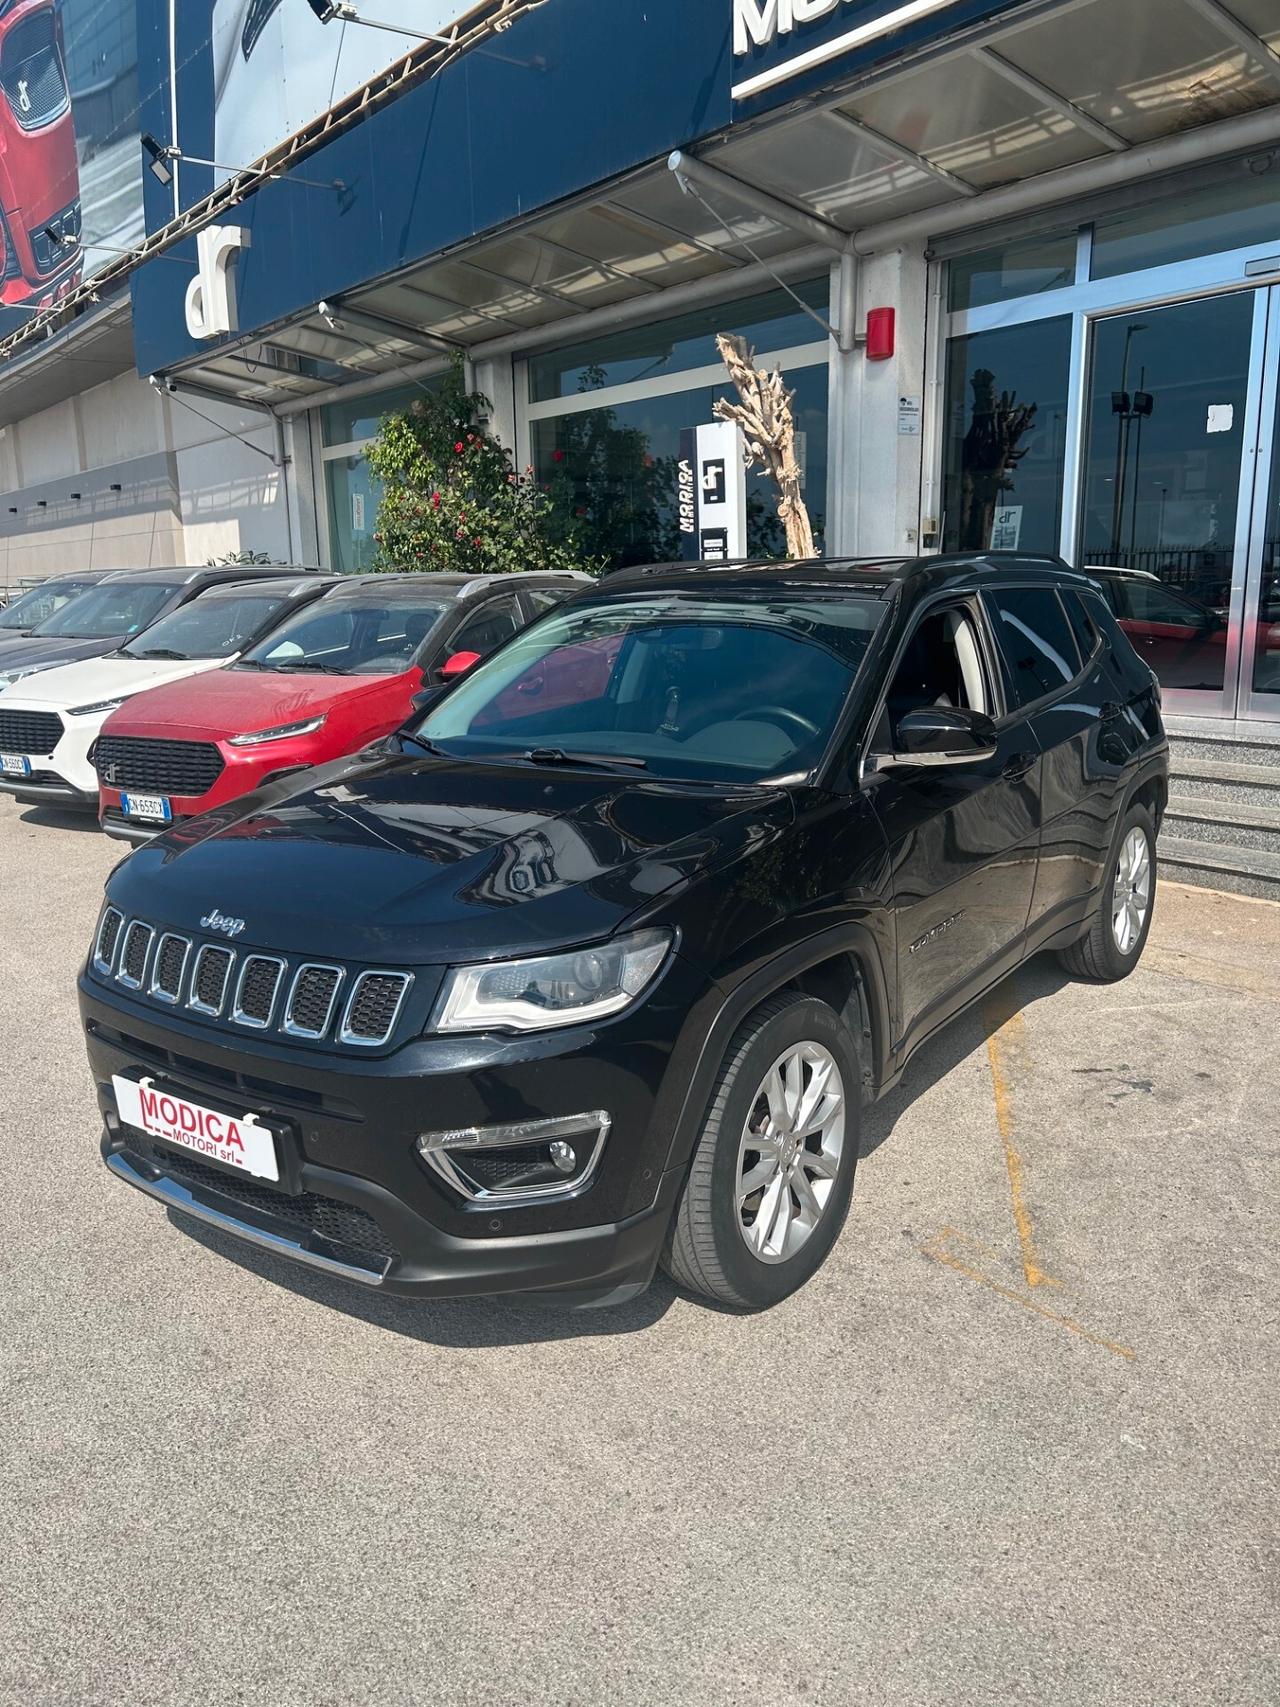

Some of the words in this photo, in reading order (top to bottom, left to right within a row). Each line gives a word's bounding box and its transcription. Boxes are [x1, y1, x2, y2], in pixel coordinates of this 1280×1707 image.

[185, 225, 250, 340] dr
[999, 511, 1016, 524] dr
[200, 909, 245, 936] Jeep
[139, 1088, 245, 1152] MODICA
[172, 1129, 217, 1156] MOTORI
[220, 1150, 235, 1163] srl
